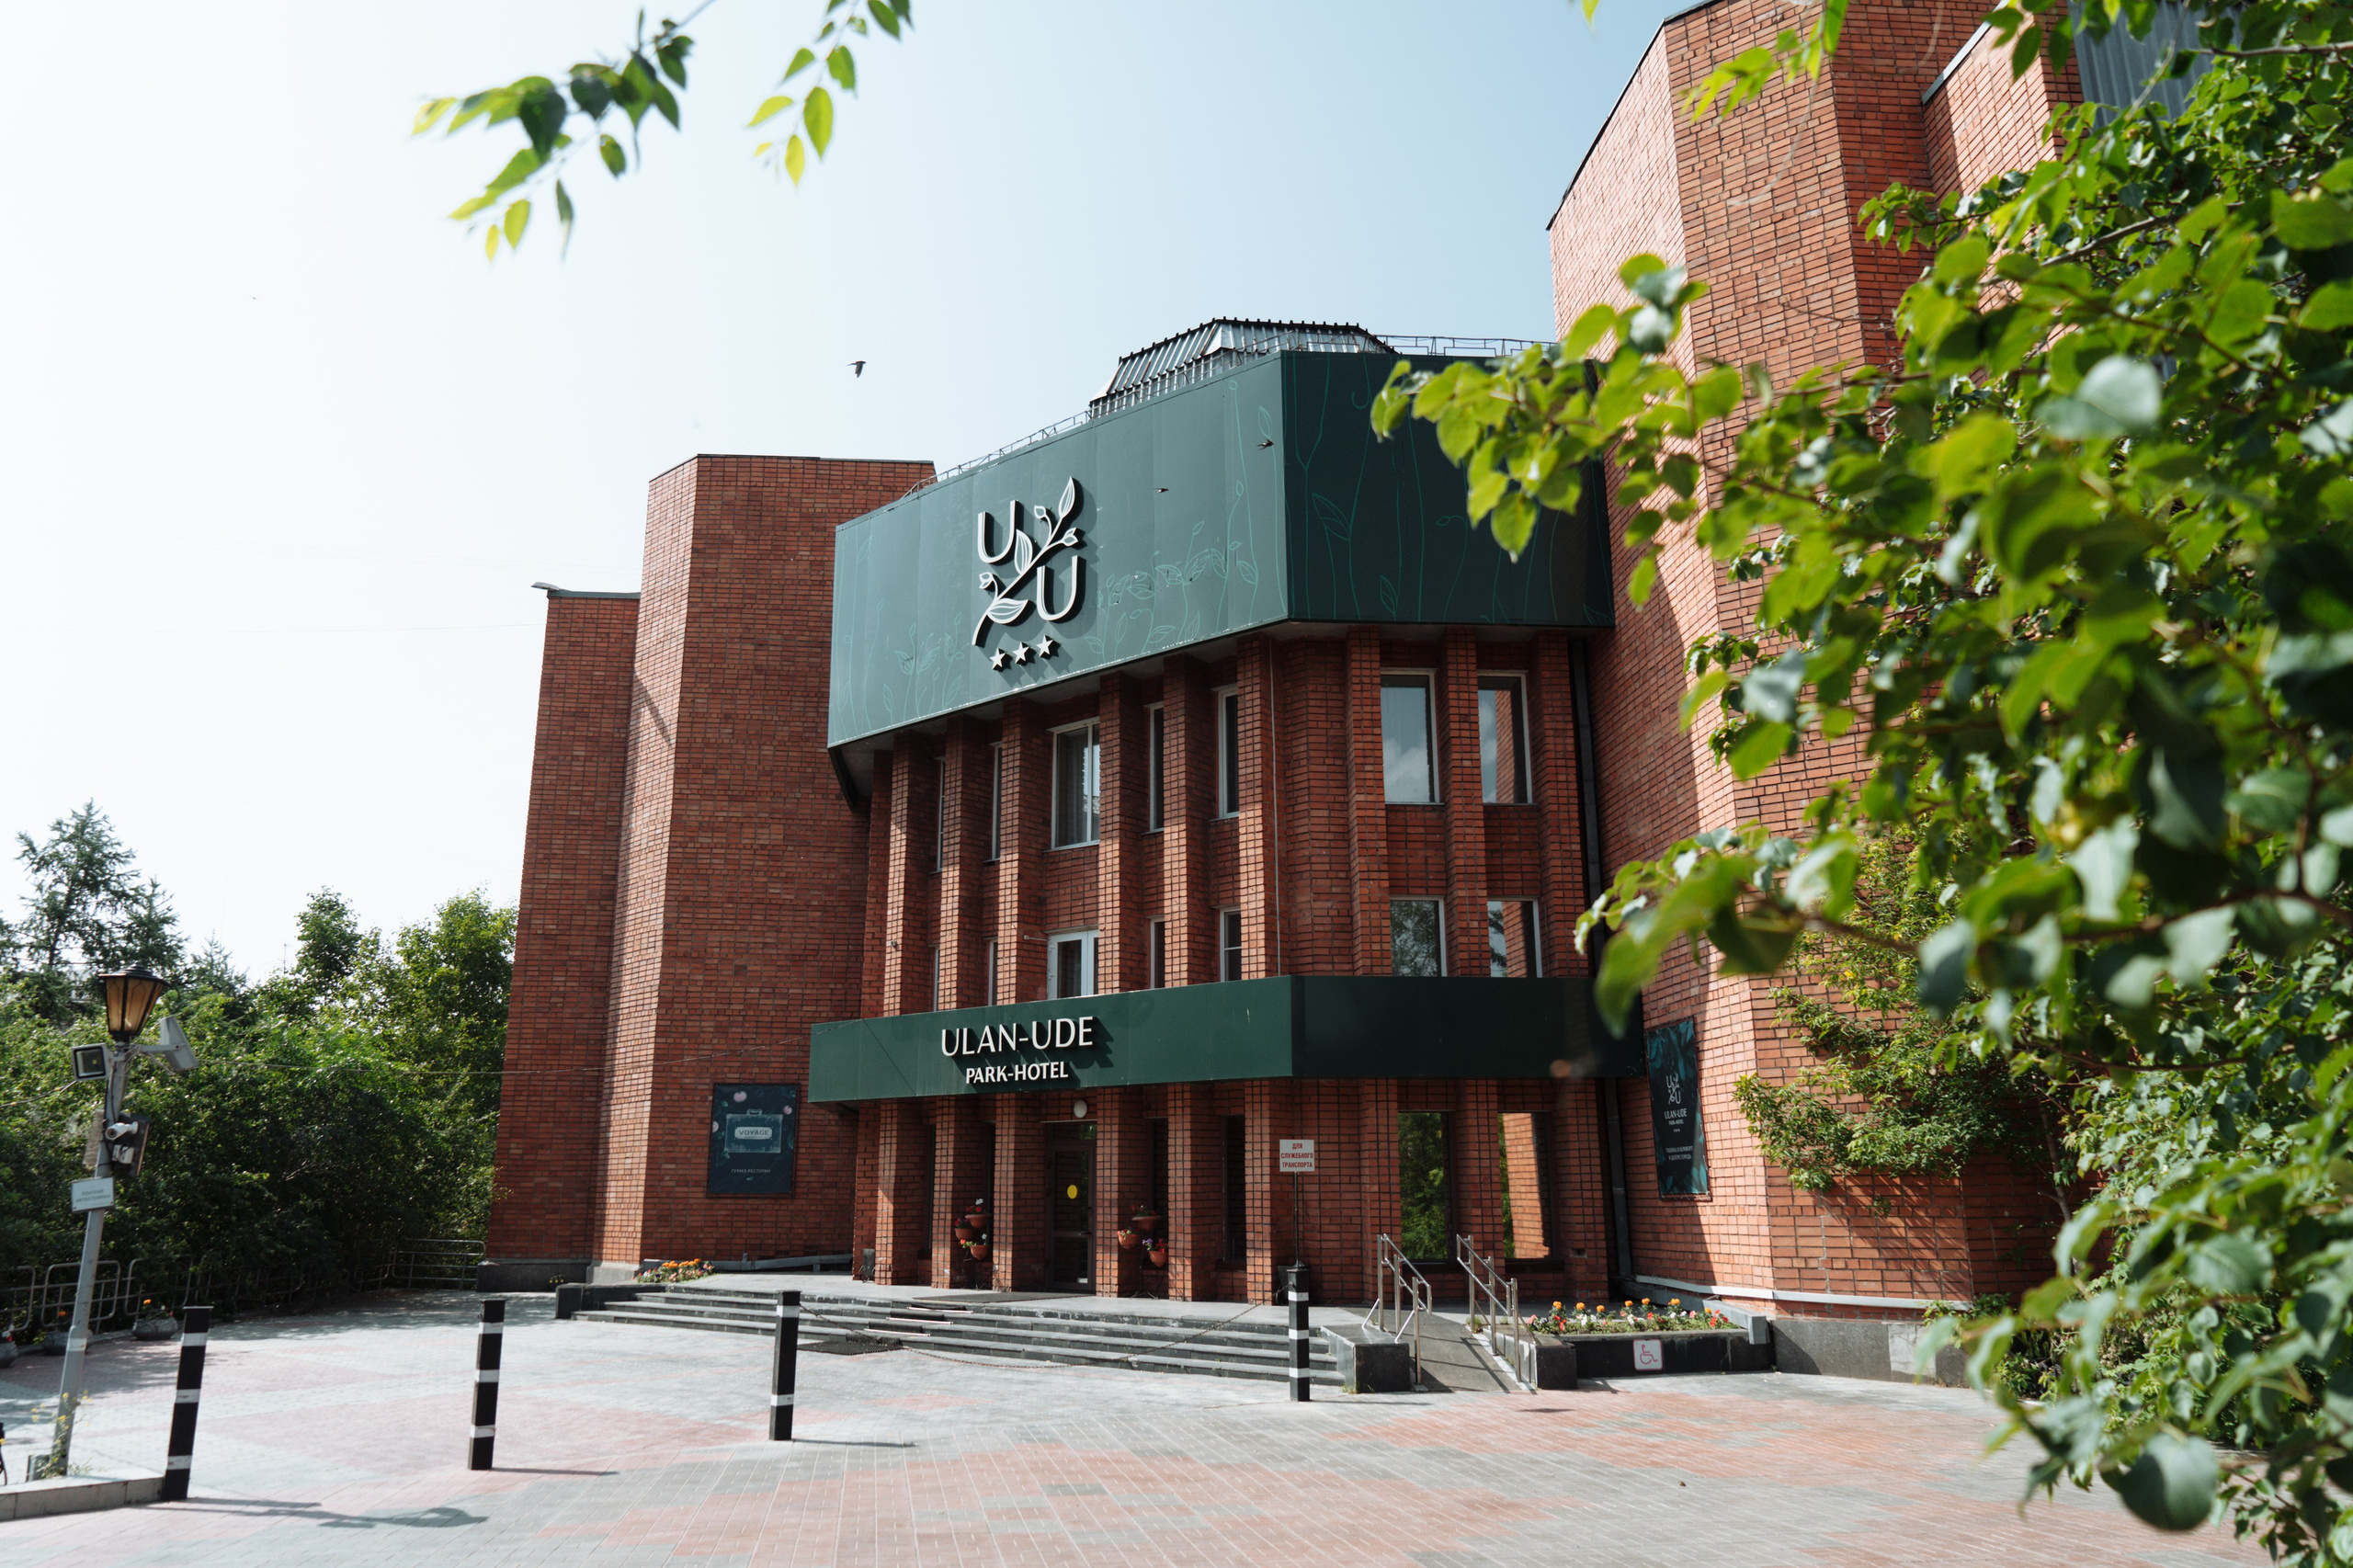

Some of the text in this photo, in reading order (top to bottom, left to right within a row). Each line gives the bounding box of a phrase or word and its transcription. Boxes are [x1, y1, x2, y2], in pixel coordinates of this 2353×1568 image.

[978, 500, 1018, 563] U
[1037, 555, 1079, 620] U
[941, 1017, 1094, 1057] ULAN-UDE
[966, 1062, 1068, 1085] PARK-HOTEL
[1664, 1108, 1688, 1119] ULAN-UDE
